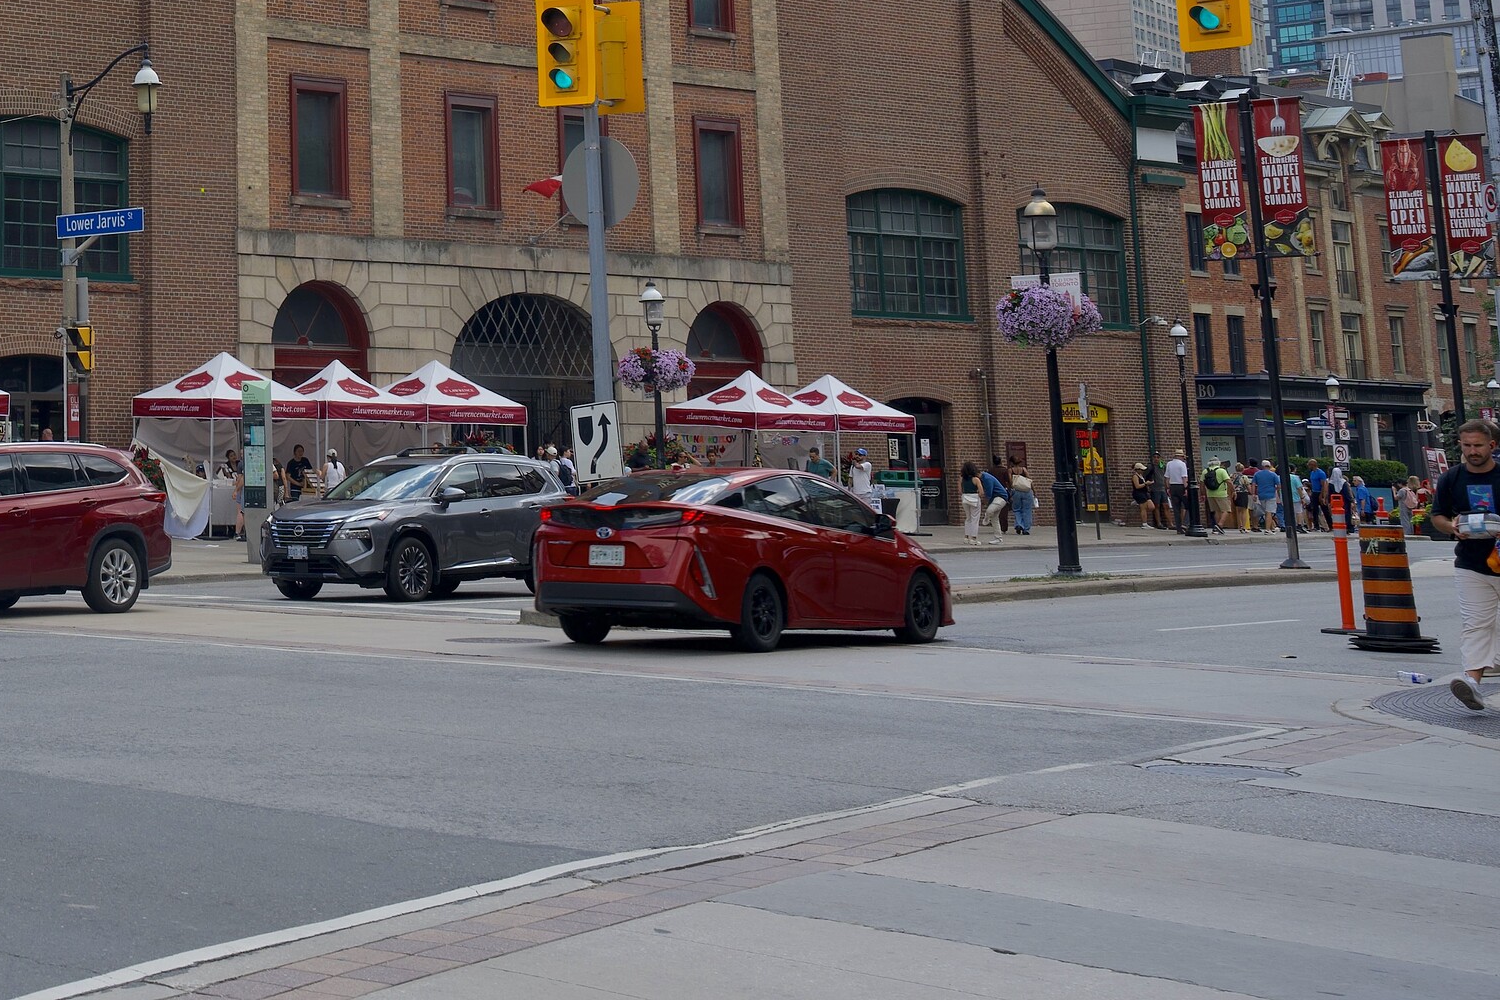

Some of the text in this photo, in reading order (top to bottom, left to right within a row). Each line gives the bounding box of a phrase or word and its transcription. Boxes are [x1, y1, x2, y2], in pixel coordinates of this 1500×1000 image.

[1202, 168, 1238, 181] MARKET
[1262, 163, 1299, 177] MARKET
[1203, 180, 1239, 198] OPEN
[1263, 176, 1301, 194] OPEN
[1446, 181, 1481, 193] MARKET
[1205, 197, 1240, 209] SUNDAYS
[1265, 193, 1302, 206] SUNDAYS
[1389, 198, 1424, 209] MARKET
[1447, 192, 1483, 208] OPEN
[1390, 209, 1426, 225] OPEN
[1448, 207, 1484, 219] WEEKDAY
[66, 217, 94, 232] Lower
[96, 212, 126, 229] Jarvis
[1450, 217, 1486, 228] EVENINGS
[1392, 224, 1427, 235] SUNDAYS
[1451, 228, 1488, 238] UNTIL 7PM
[1197, 384, 1216, 398] BO
[352, 407, 415, 416] stlawrencemarket.com
[449, 410, 514, 419] stlawrencemarket.com
